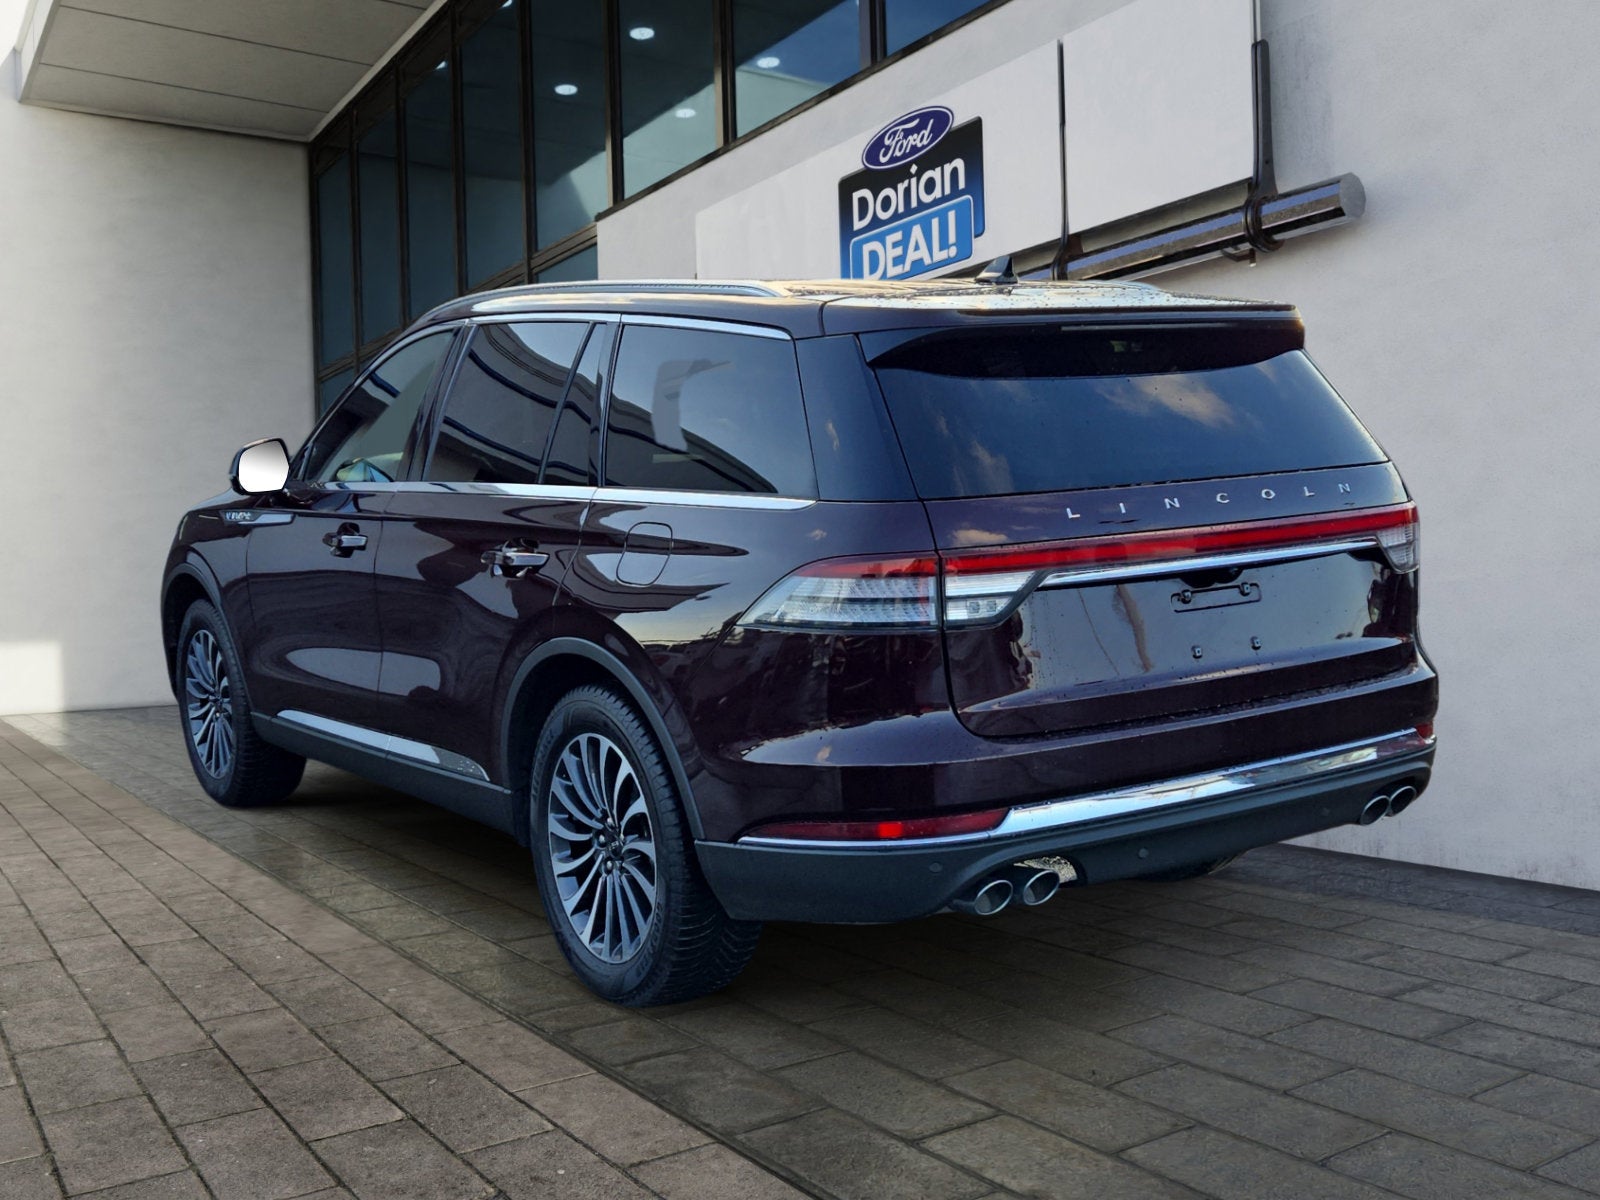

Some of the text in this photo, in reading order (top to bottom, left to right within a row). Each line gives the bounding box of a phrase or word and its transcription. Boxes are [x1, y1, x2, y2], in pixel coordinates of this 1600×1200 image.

[879, 118, 934, 163] Ford
[852, 158, 966, 231] Dorian
[862, 210, 957, 280] DEAL!
[1066, 483, 1351, 519] LINCOLN
